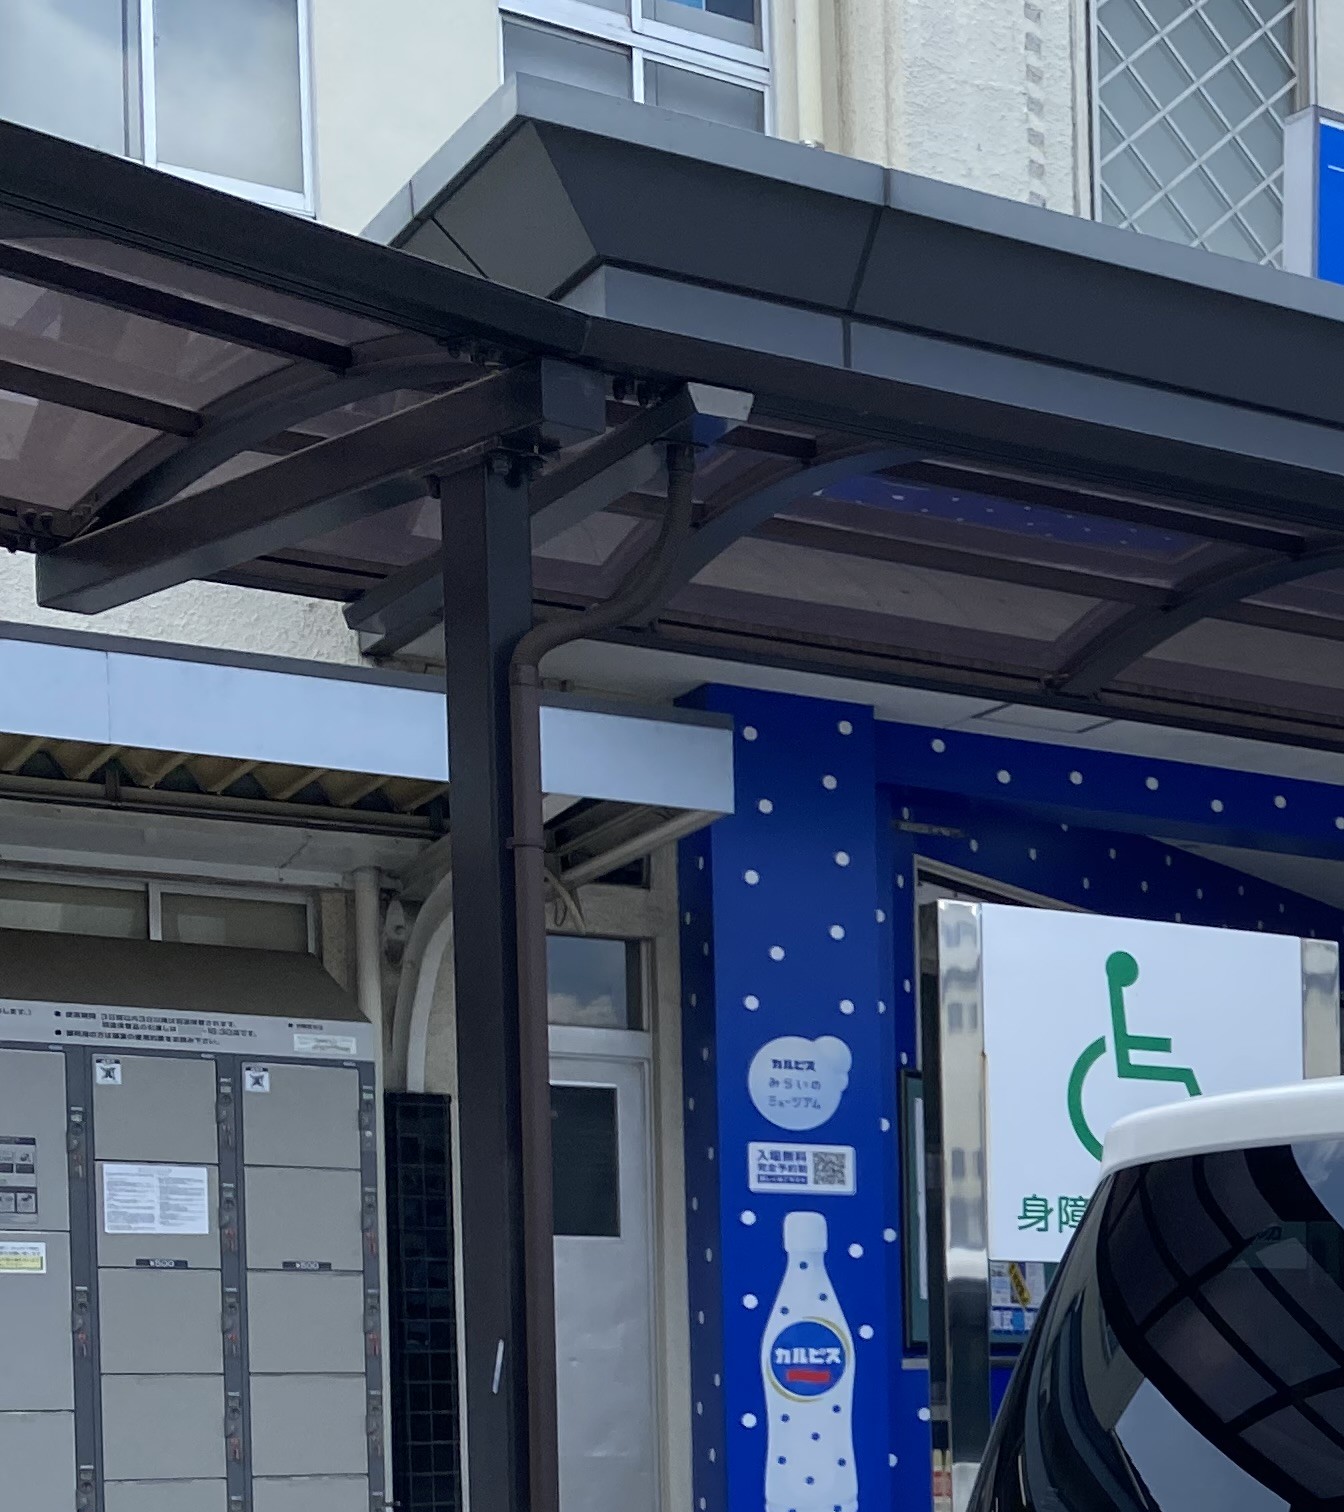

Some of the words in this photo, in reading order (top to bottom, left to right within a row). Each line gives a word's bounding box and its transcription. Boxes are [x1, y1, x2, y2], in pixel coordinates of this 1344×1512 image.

[771, 1059, 816, 1072] カルピス
[769, 1077, 821, 1090] みらいの
[768, 1095, 821, 1110] ミュージアム
[774, 1347, 841, 1365] カルピス
